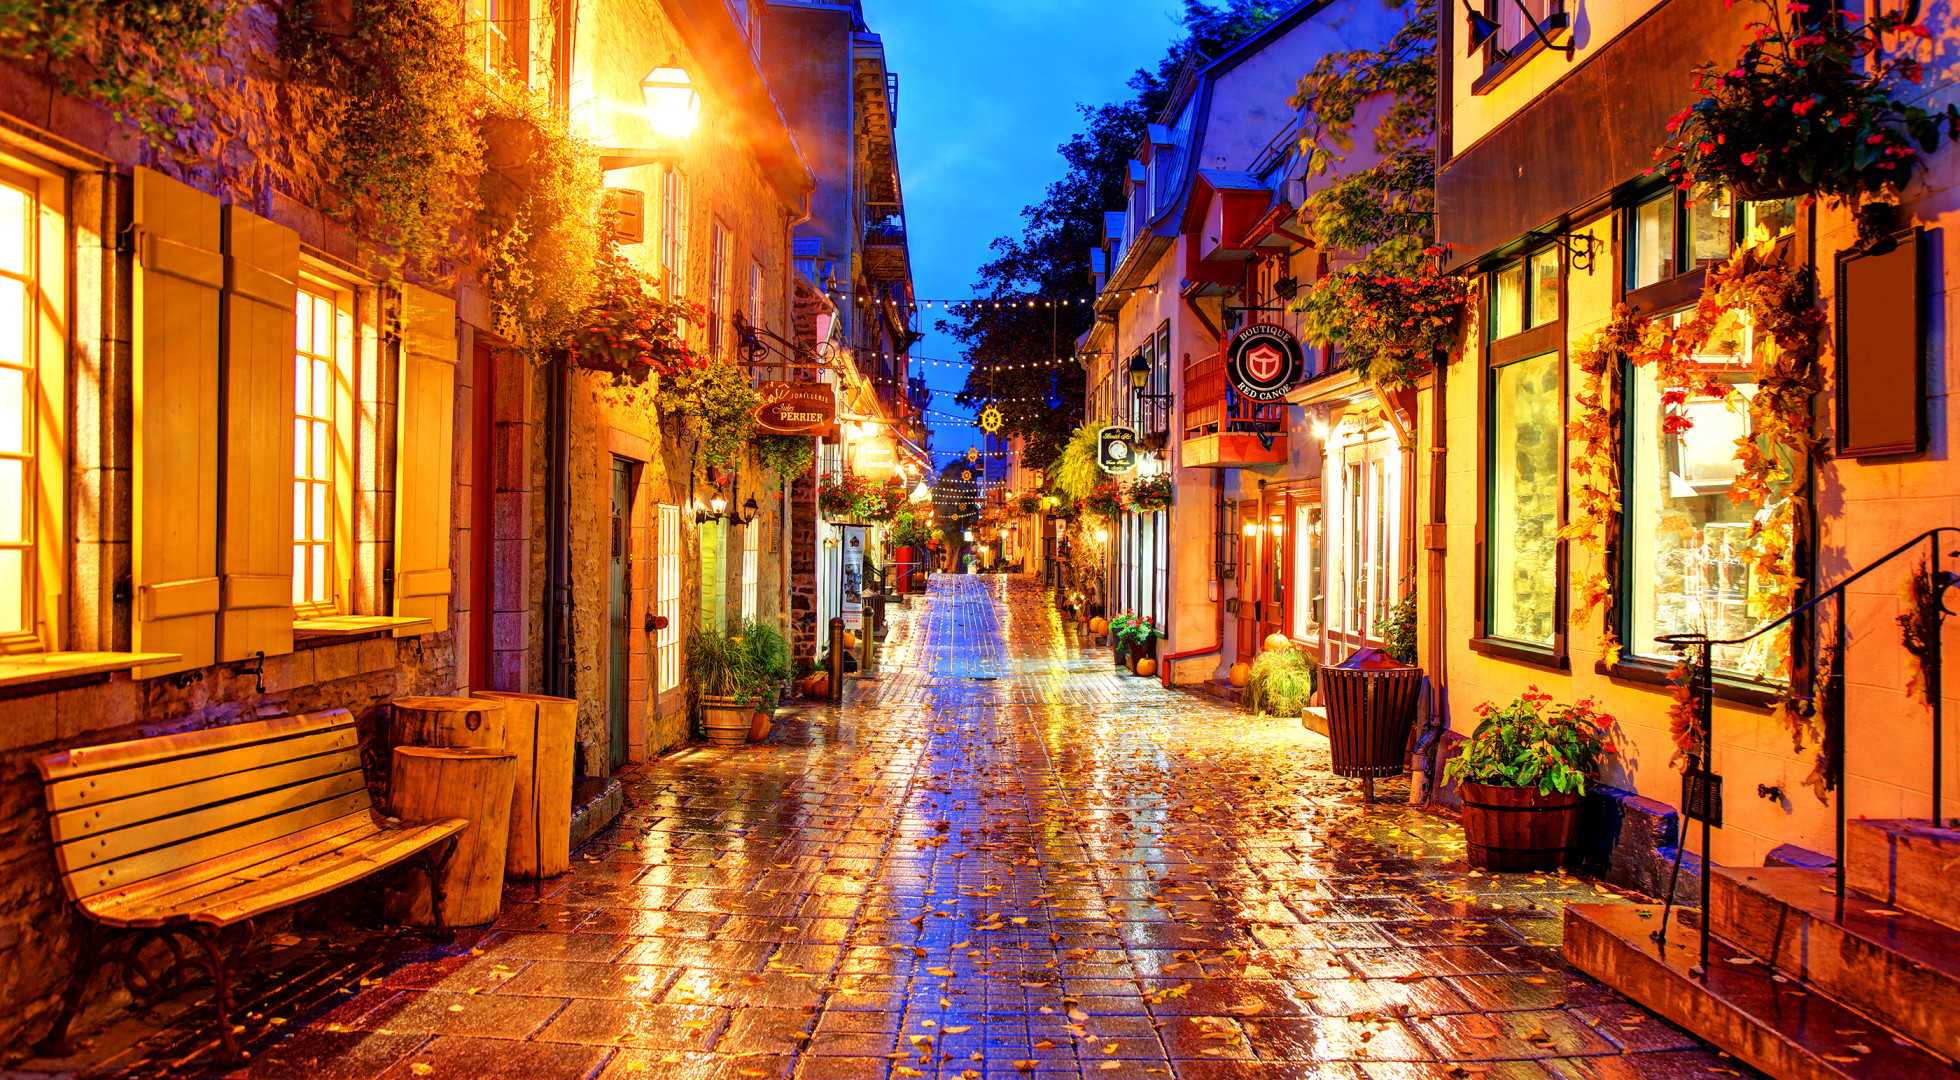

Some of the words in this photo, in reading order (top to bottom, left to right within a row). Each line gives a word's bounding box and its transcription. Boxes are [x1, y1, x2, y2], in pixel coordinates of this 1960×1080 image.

[1239, 325, 1291, 342] BOUTIQUE
[1237, 382, 1258, 398] RED
[1259, 384, 1291, 400] CANOE
[791, 393, 829, 404] JOAILLERIE
[772, 403, 795, 414] Jules
[780, 412, 825, 426] PERRIER
